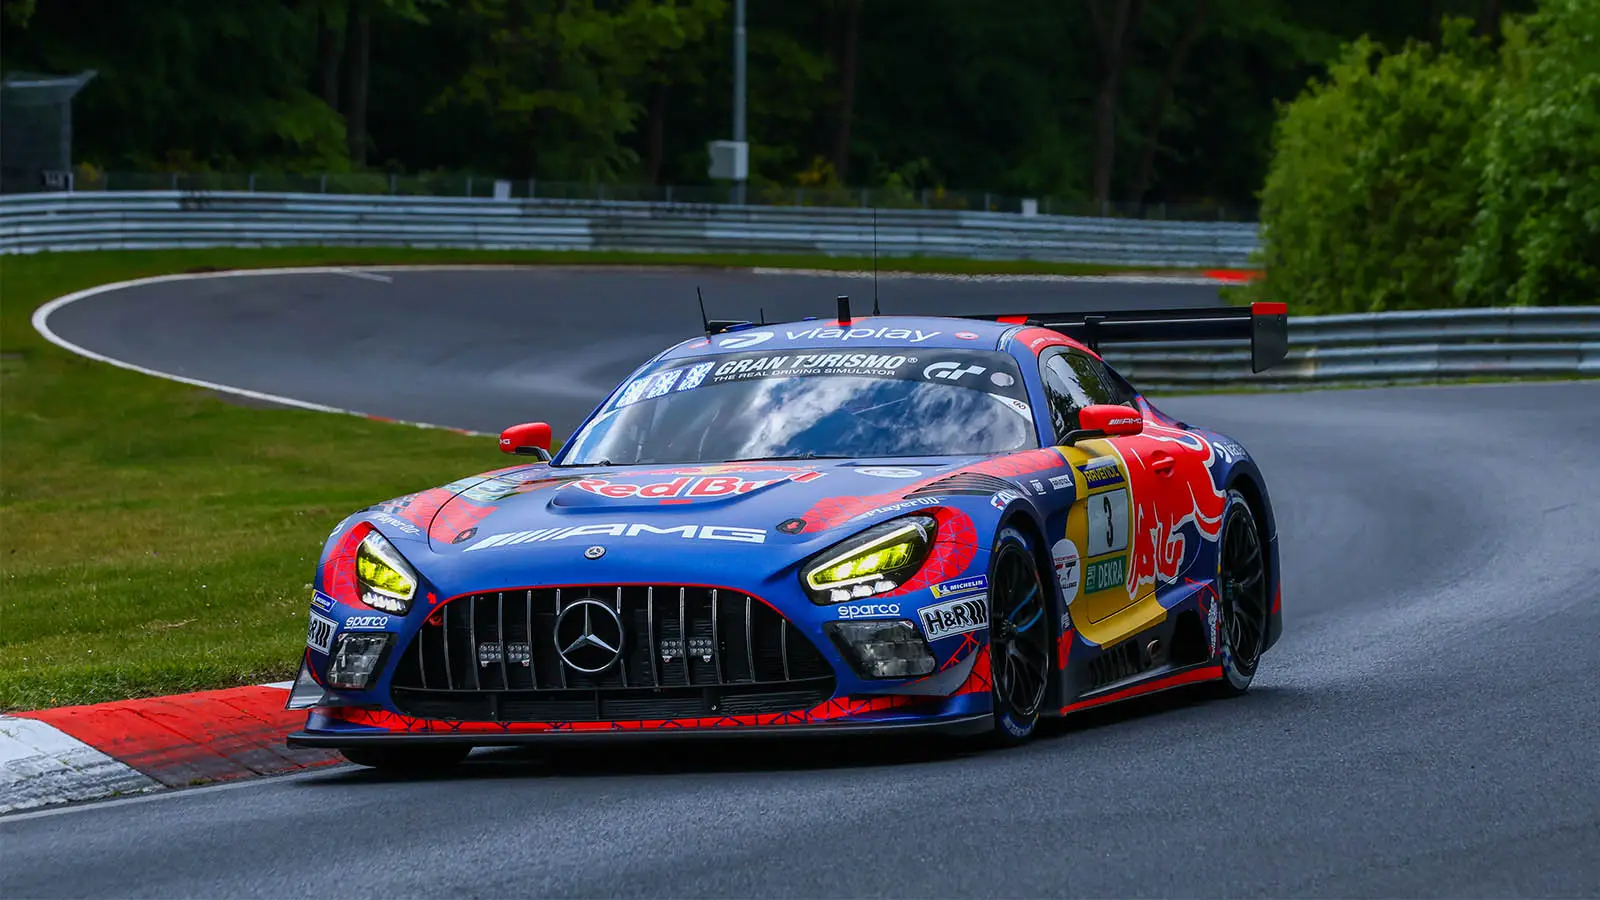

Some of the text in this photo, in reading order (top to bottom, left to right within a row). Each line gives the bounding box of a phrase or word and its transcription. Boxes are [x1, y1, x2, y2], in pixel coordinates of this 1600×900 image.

[785, 326, 942, 343] viaplay
[713, 367, 896, 383] THE REAL DRIVING SIMULATOR
[717, 357, 790, 376] GRAN
[1083, 466, 1120, 482] RAVENOL
[556, 477, 694, 498] Red
[1103, 496, 1114, 547] 3
[551, 523, 767, 544] AMG
[1098, 560, 1123, 588] DEKRA
[949, 580, 983, 591] MICHELIN
[838, 603, 899, 618] sparco
[924, 604, 970, 633] H&R
[344, 616, 388, 629] sparco
